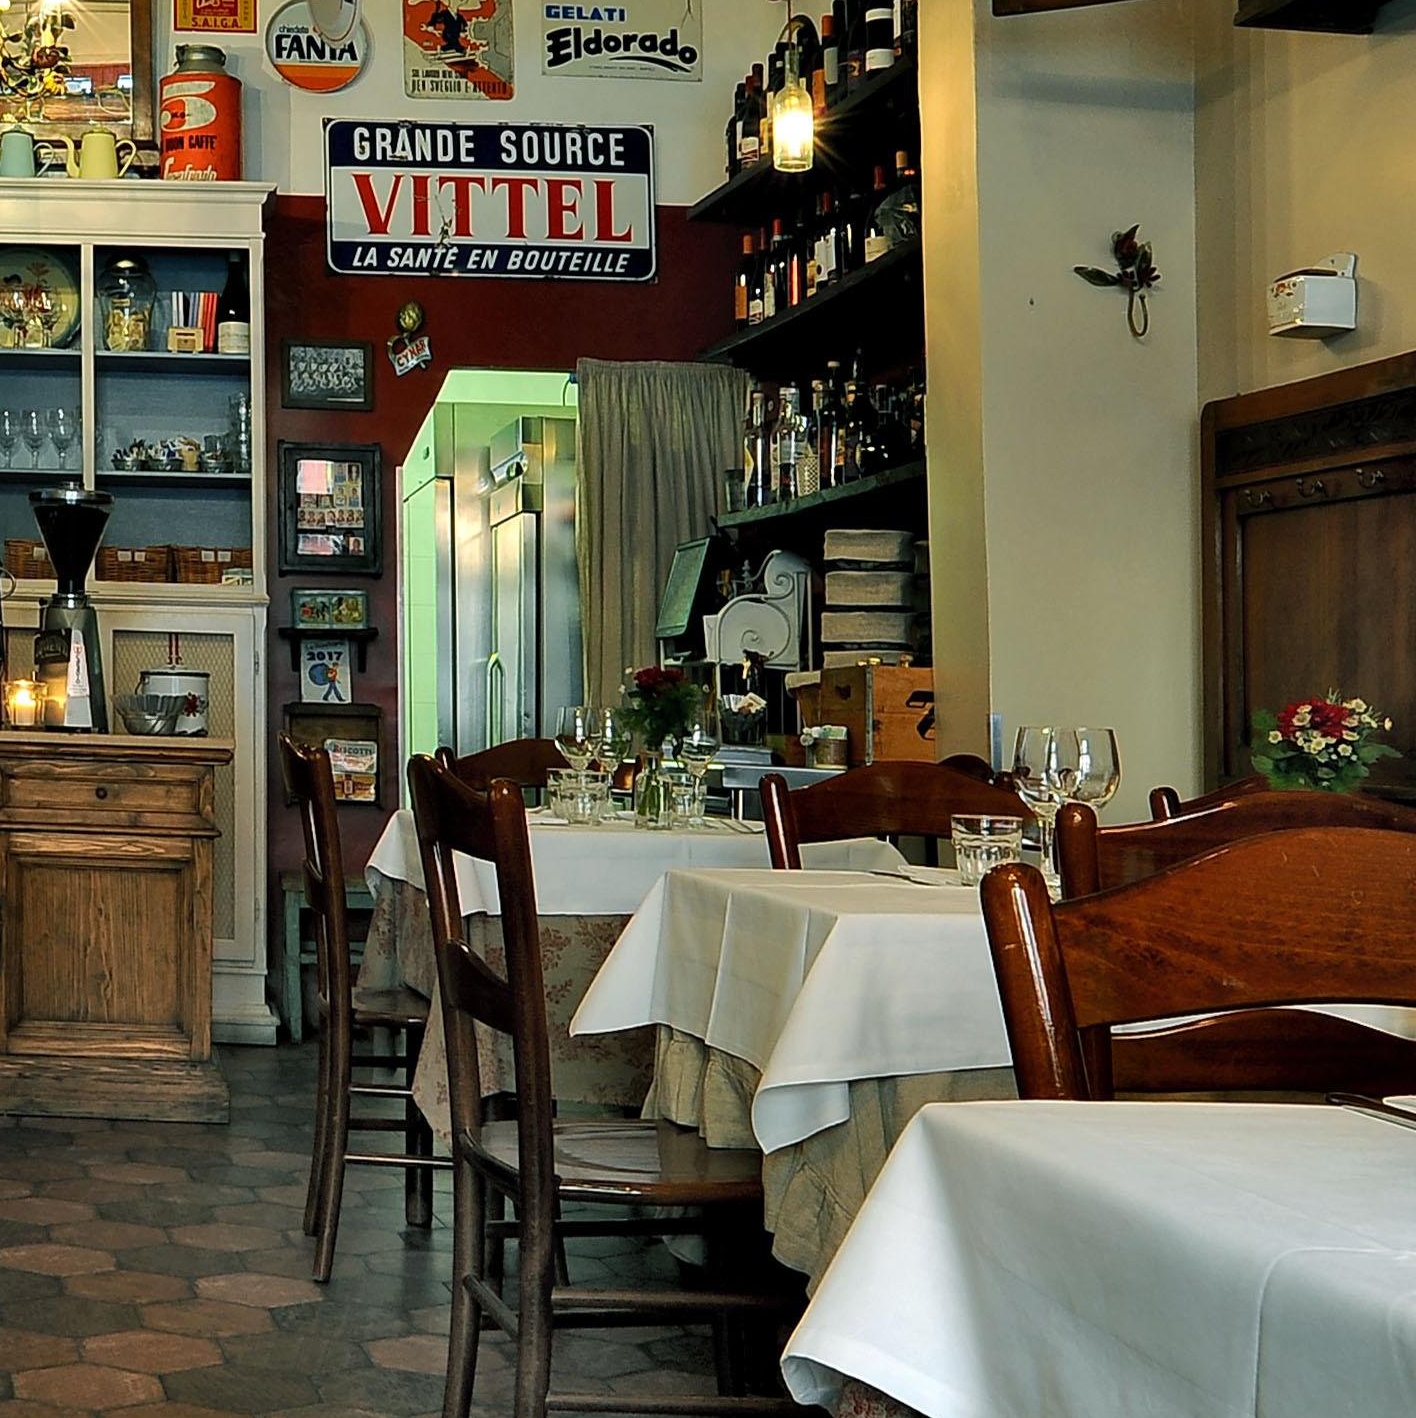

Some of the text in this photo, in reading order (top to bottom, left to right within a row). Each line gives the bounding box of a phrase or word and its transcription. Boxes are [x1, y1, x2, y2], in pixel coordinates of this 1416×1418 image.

[545, 4, 626, 22] GELATI
[546, 27, 698, 68] Eldorado
[353, 127, 625, 166] GRANDE SOURCE
[351, 172, 634, 242] VITTEL
[352, 246, 630, 273] LA SANTÉ EN BOUTEILLE
[397, 339, 425, 367] CYNAR
[306, 651, 343, 661] 2017
